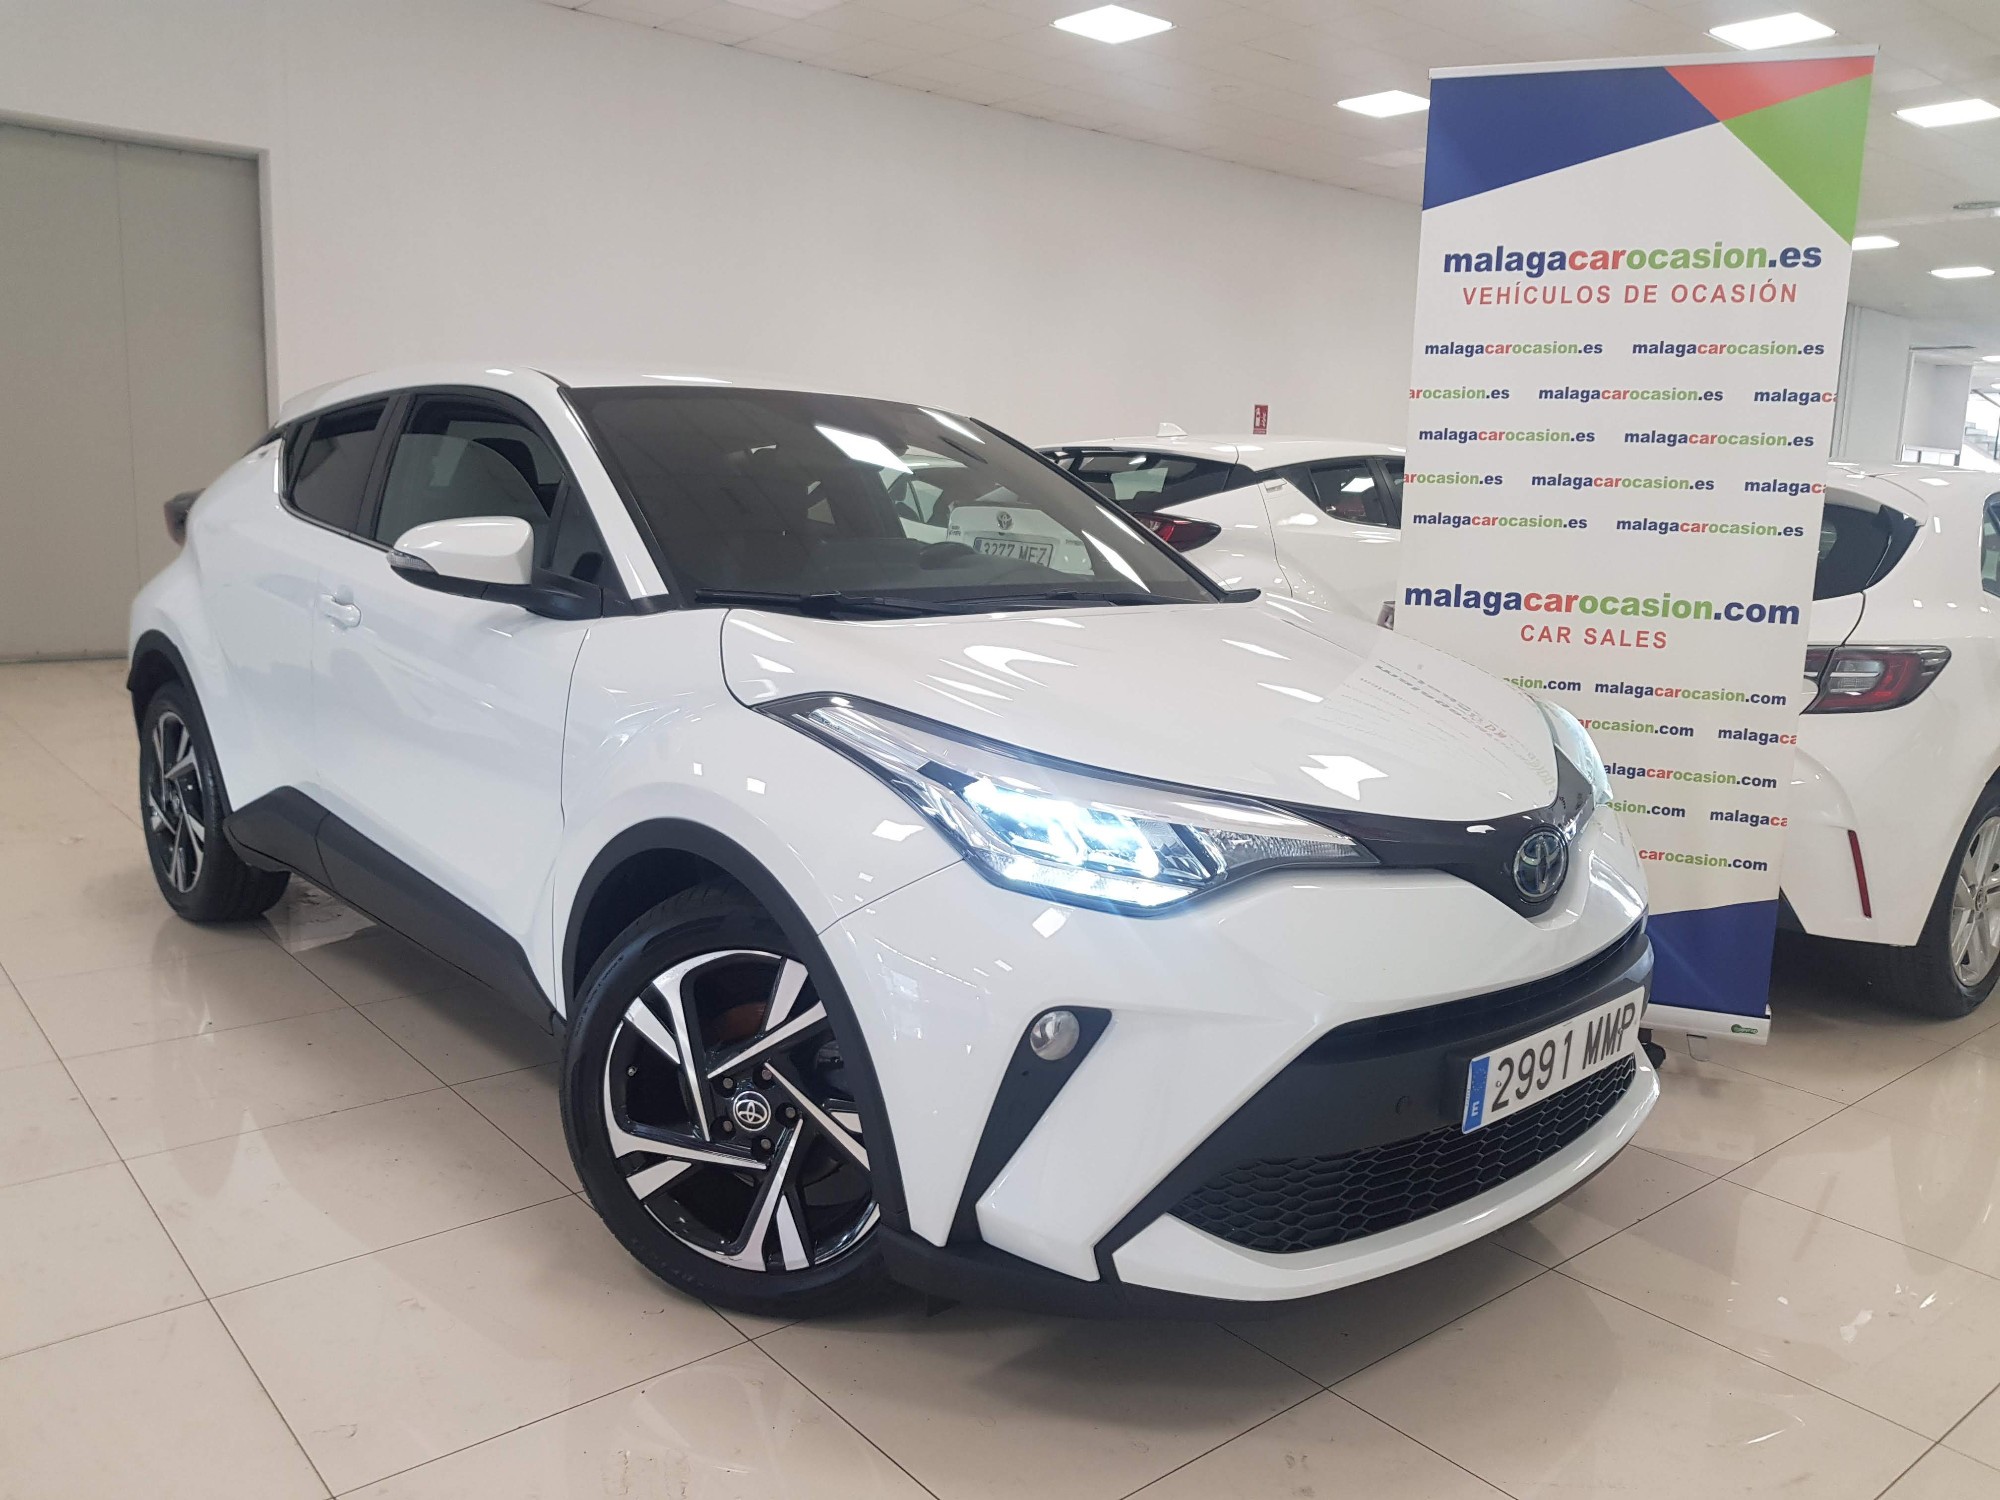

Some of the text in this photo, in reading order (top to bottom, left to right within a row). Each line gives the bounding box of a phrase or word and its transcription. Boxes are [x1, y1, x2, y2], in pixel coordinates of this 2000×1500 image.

[1443, 242, 1822, 278] malagacarocasion.es
[1463, 278, 1797, 305] VEHÍCULOS DE OCASIÓN
[1425, 341, 1825, 357] malagacarocasion.es malagacarocasion.es
[1538, 386, 1724, 402] malagacarocasion.es
[1419, 428, 1814, 447] malagacarocasion.es malagacarocasion.es
[1531, 473, 1715, 490] malagacarocasion.es
[1744, 479, 1826, 496] malagac
[1413, 512, 1804, 537] malagacarocasion.es malagacarocasion.es
[1404, 583, 1800, 625] malagacarocasion.com
[1520, 624, 1668, 649] CAR SALES
[1594, 682, 1787, 706] malagacarocasion.com
[1638, 849, 1768, 872] carocasion.com
[1471, 1002, 1636, 1117] E 2991 MMP
